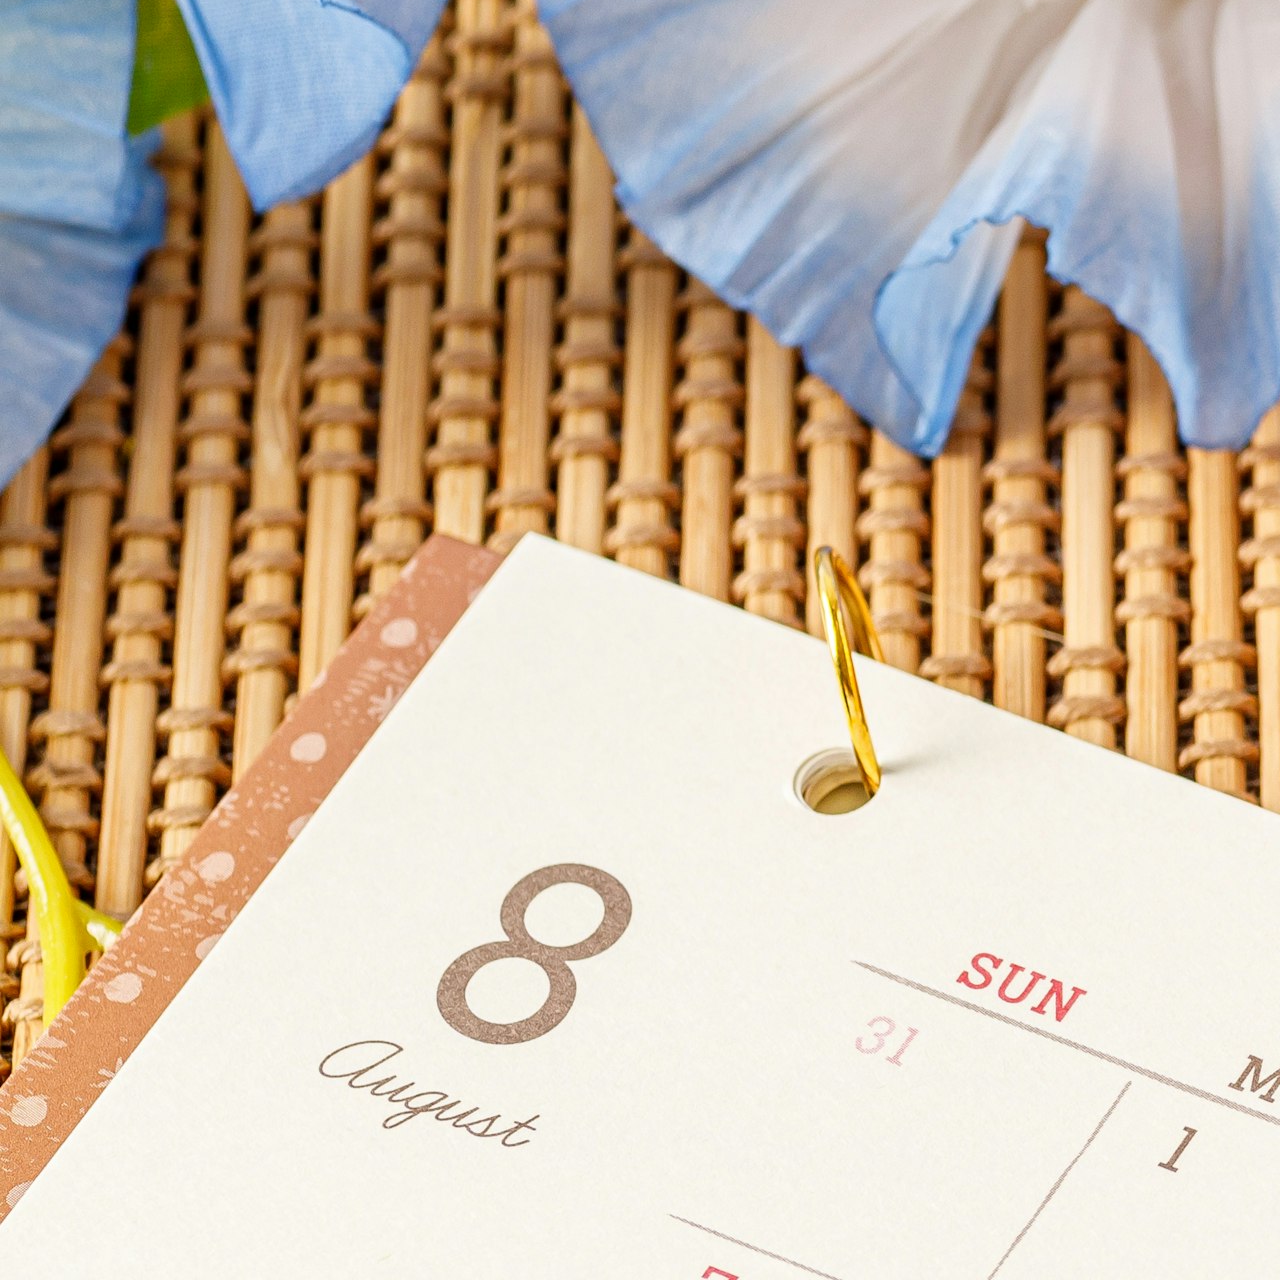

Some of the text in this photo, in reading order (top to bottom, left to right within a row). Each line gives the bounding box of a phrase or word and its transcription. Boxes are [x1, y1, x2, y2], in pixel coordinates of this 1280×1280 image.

[437, 862, 632, 1045] 8
[956, 952, 1087, 1022] SUN
[854, 1015, 919, 1067] 31
[318, 1039, 541, 1148] August
[1157, 1125, 1198, 1173] 1
